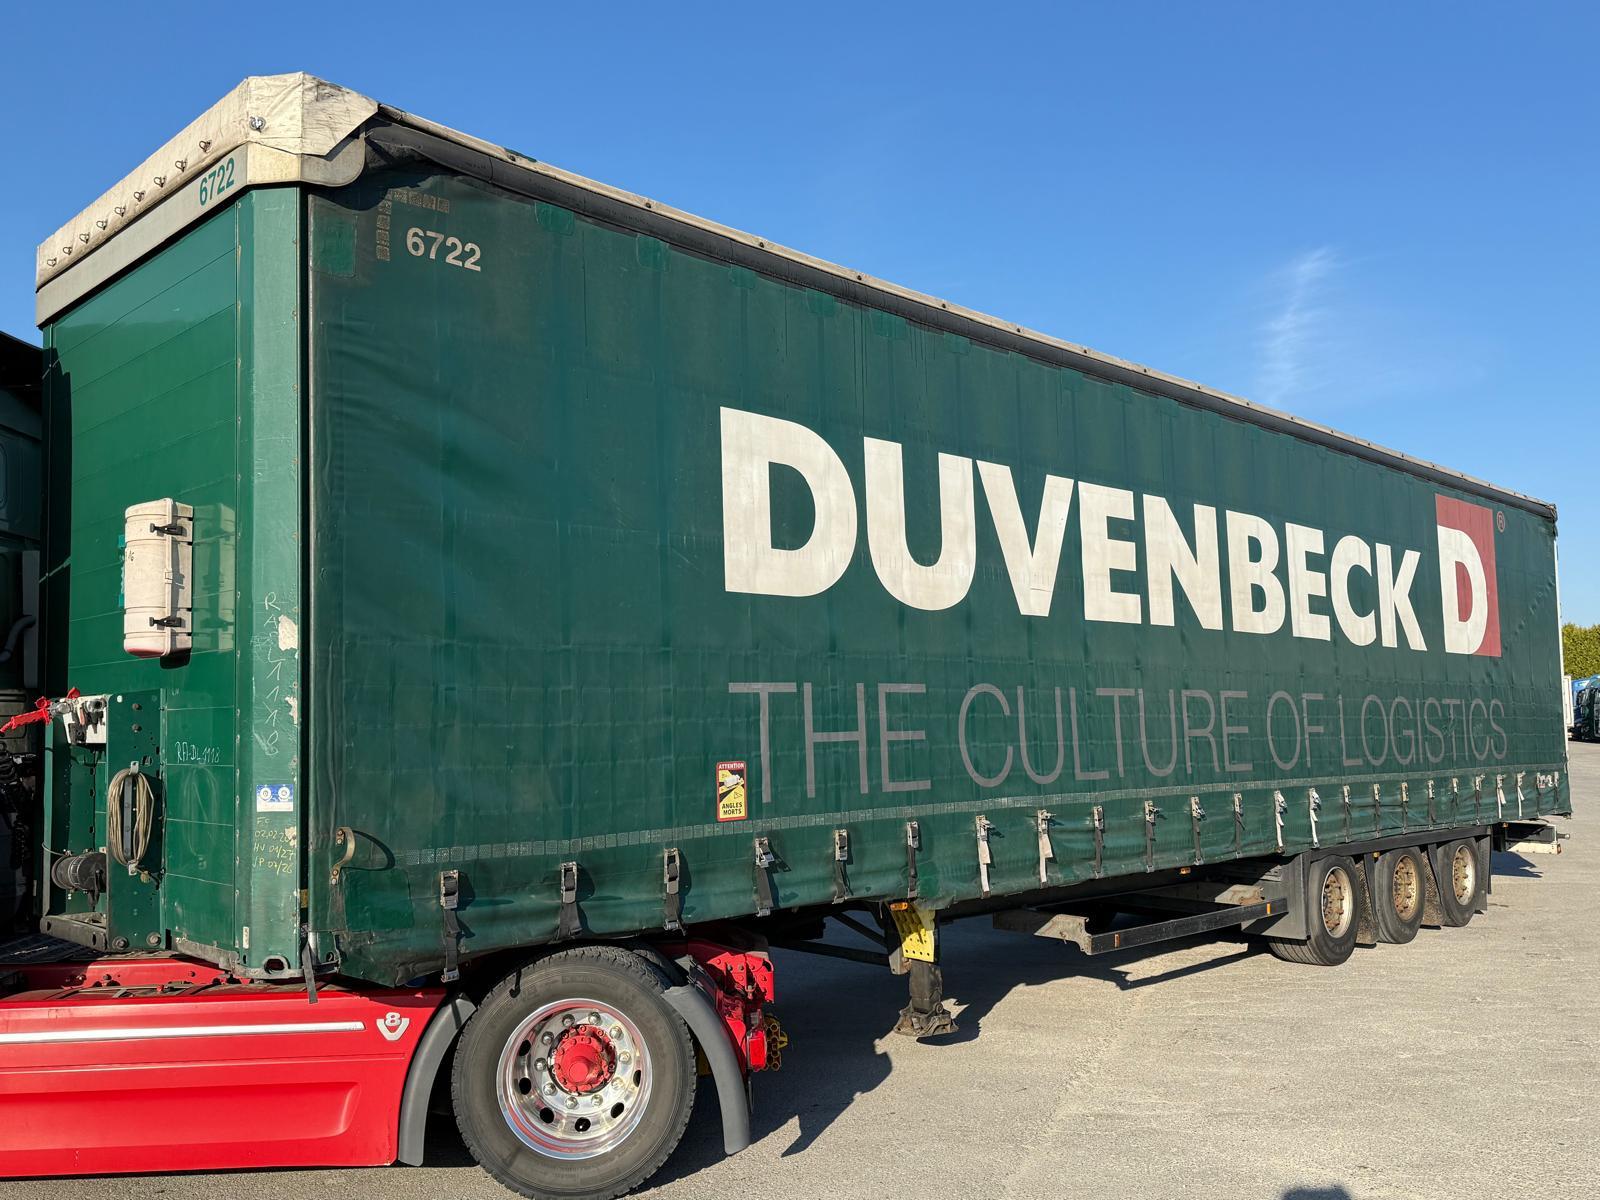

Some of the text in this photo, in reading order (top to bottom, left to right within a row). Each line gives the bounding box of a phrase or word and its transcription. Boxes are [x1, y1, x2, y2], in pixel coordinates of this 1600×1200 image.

[199, 157, 235, 206] 6722
[406, 227, 481, 272] 6722
[720, 406, 1428, 652] DUVENBECK
[1437, 524, 1489, 655] D
[728, 682, 1508, 804] THE CULTURE OF LOGISTICS
[722, 802, 743, 810] ANGLES
